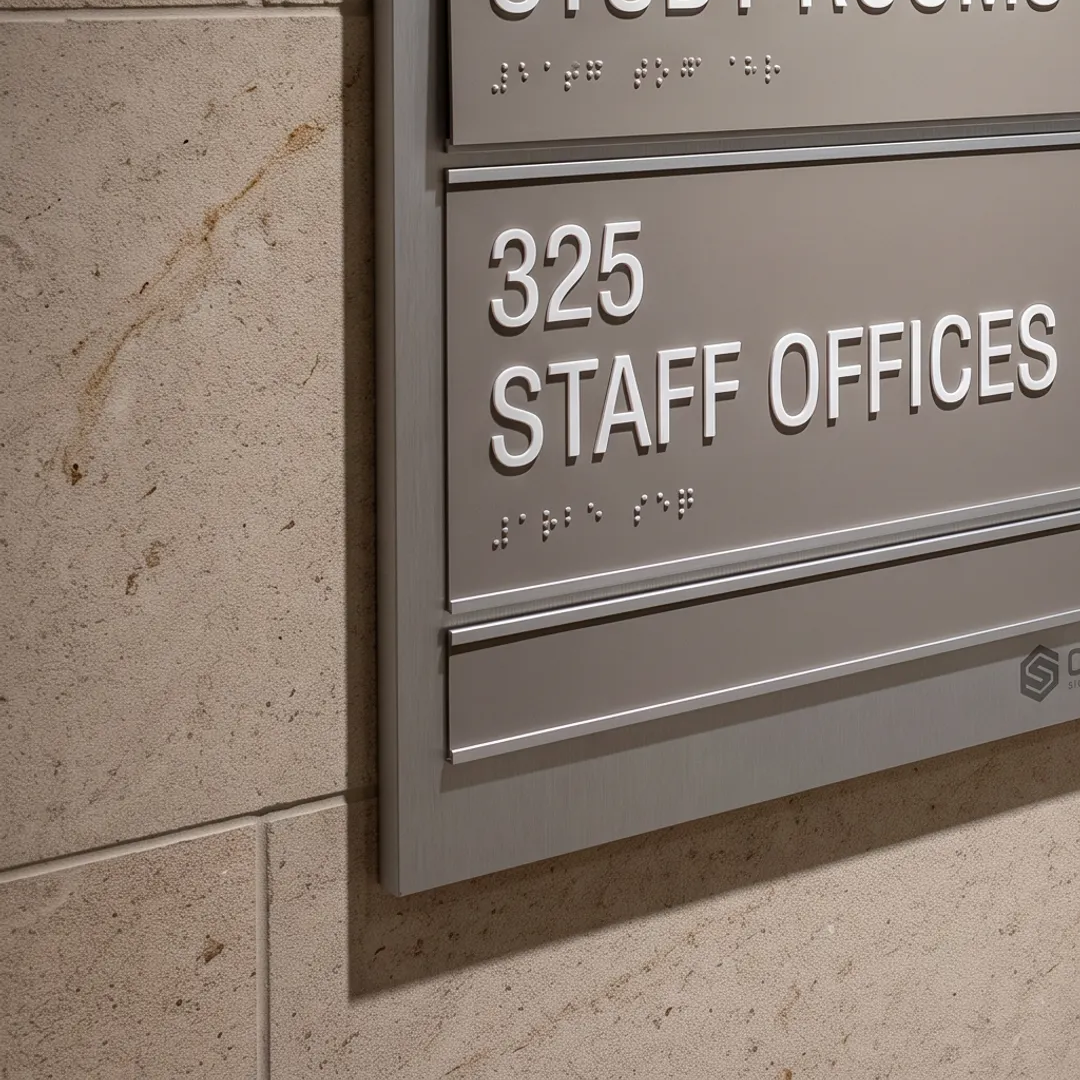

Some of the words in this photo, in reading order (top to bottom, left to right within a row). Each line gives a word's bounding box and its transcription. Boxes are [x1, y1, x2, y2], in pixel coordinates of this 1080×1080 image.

[491, 221, 644, 328] 325
[491, 341, 742, 468] STAFF
[770, 303, 1058, 427] OFFICES
